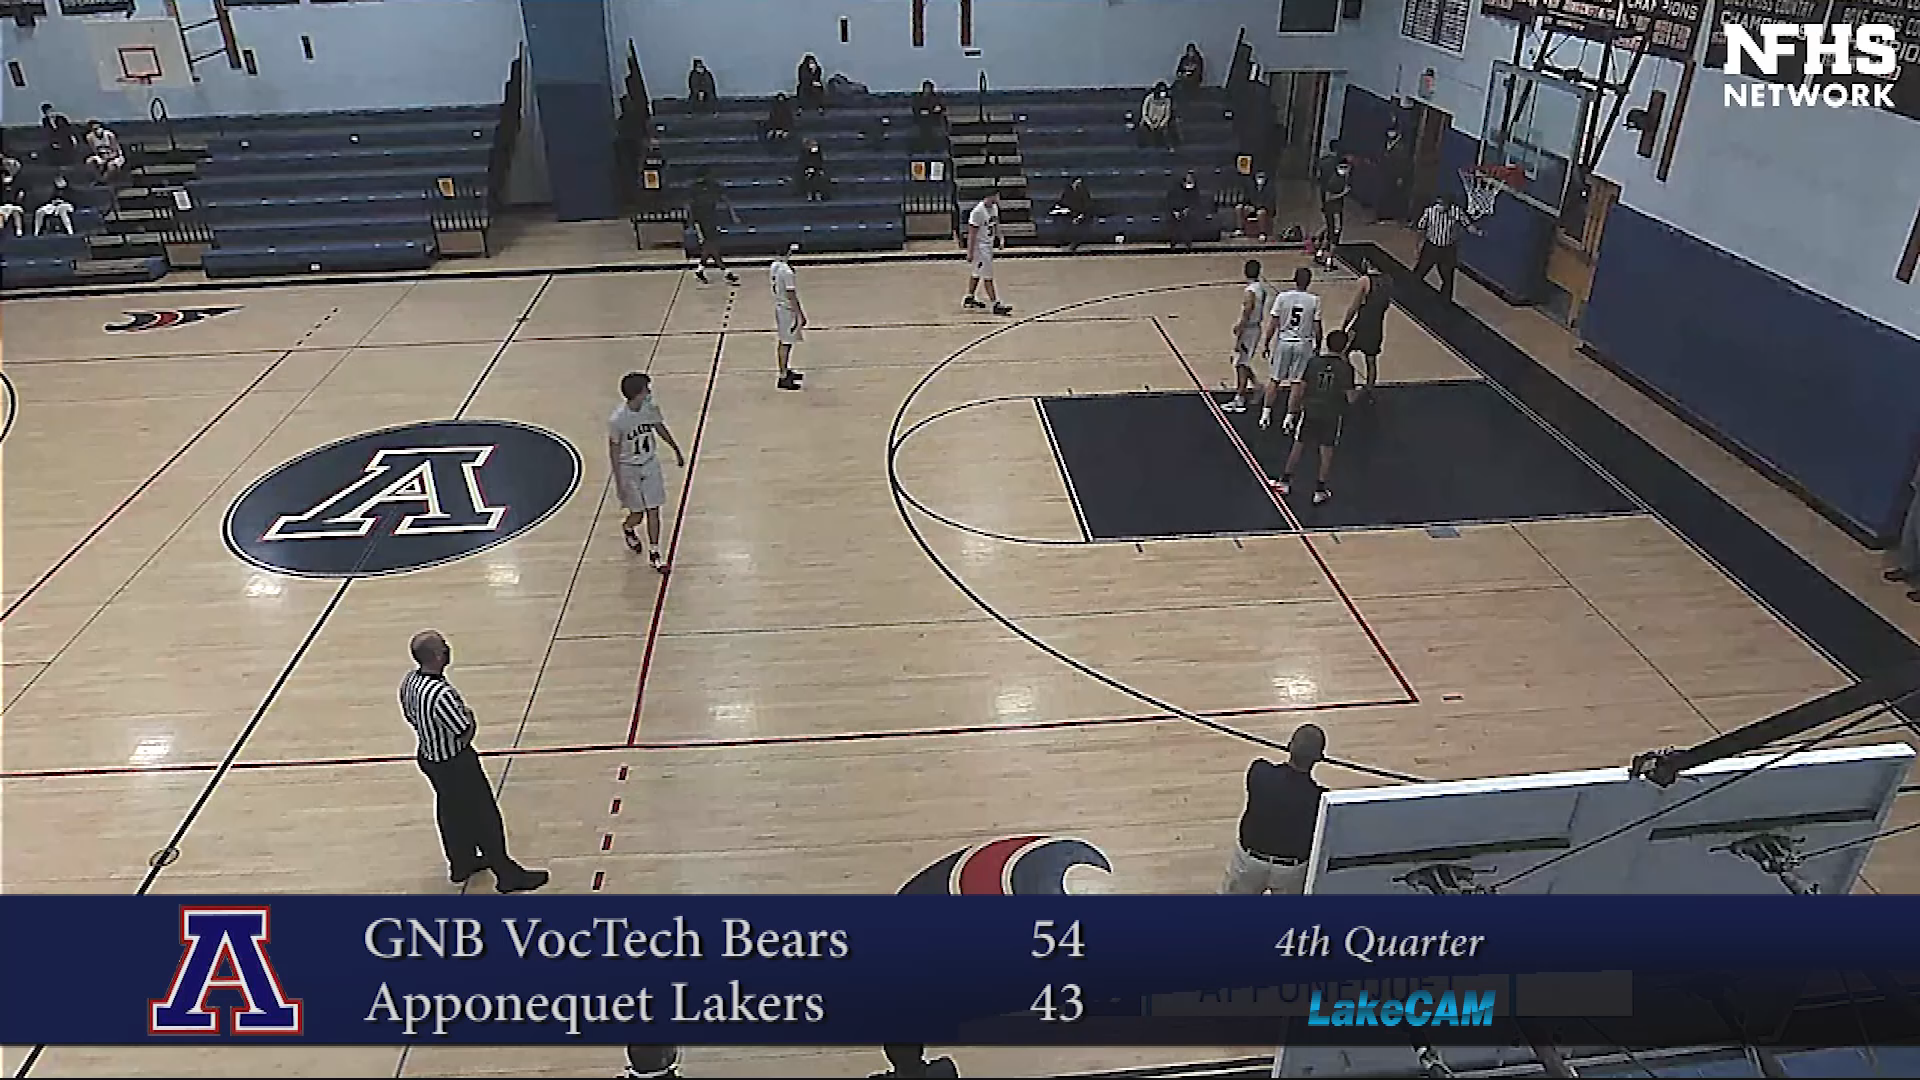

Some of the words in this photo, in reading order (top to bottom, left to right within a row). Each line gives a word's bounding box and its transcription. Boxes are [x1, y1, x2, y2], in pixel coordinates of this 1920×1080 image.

[1290, 307, 1303, 327] 5
[633, 436, 650, 455] 14
[260, 445, 508, 541] A
